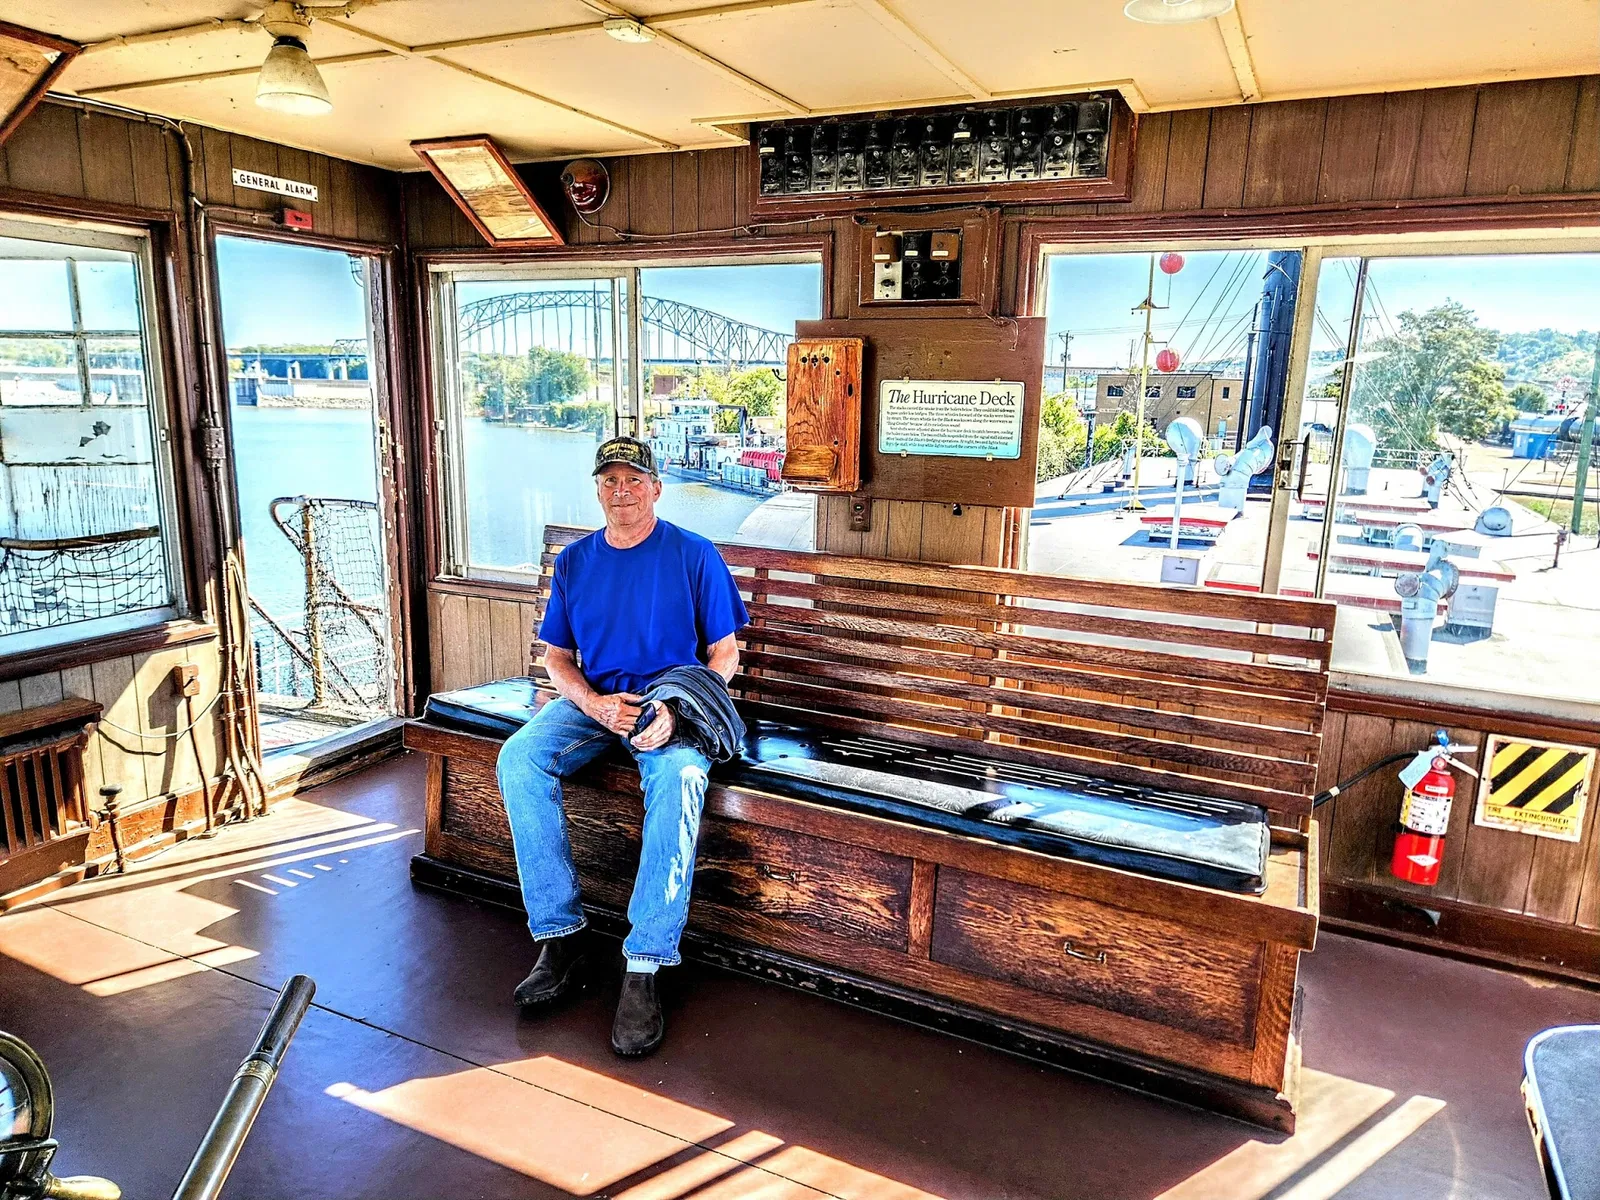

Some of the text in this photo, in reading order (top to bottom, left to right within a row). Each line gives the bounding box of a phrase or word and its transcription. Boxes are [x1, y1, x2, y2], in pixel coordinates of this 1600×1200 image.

[240, 174, 312, 196] GENERAL ALARM
[888, 389, 1016, 406] The Hurricane Deck
